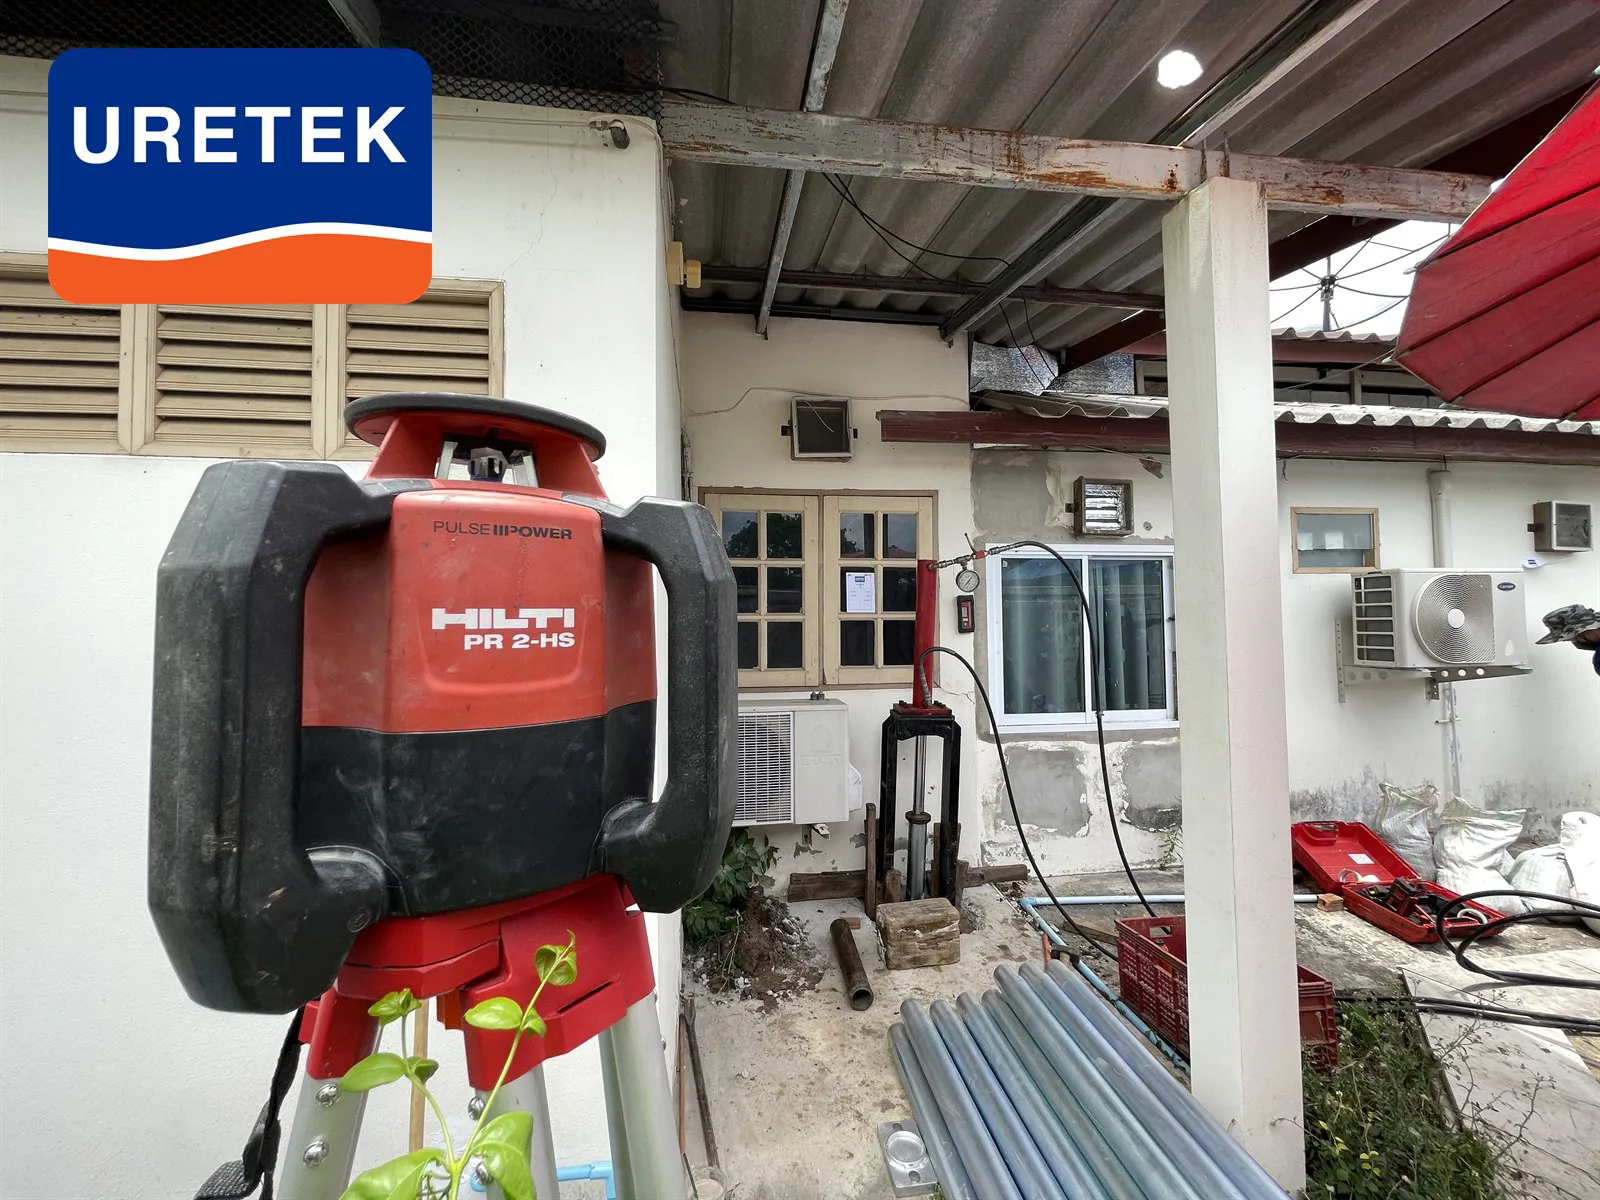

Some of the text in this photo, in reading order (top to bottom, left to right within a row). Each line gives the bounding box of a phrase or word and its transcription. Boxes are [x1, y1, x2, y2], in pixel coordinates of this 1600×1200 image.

[433, 521, 490, 535] PULSE
[431, 608, 575, 630] HILTI
[464, 632, 575, 650] PR 2-HS
